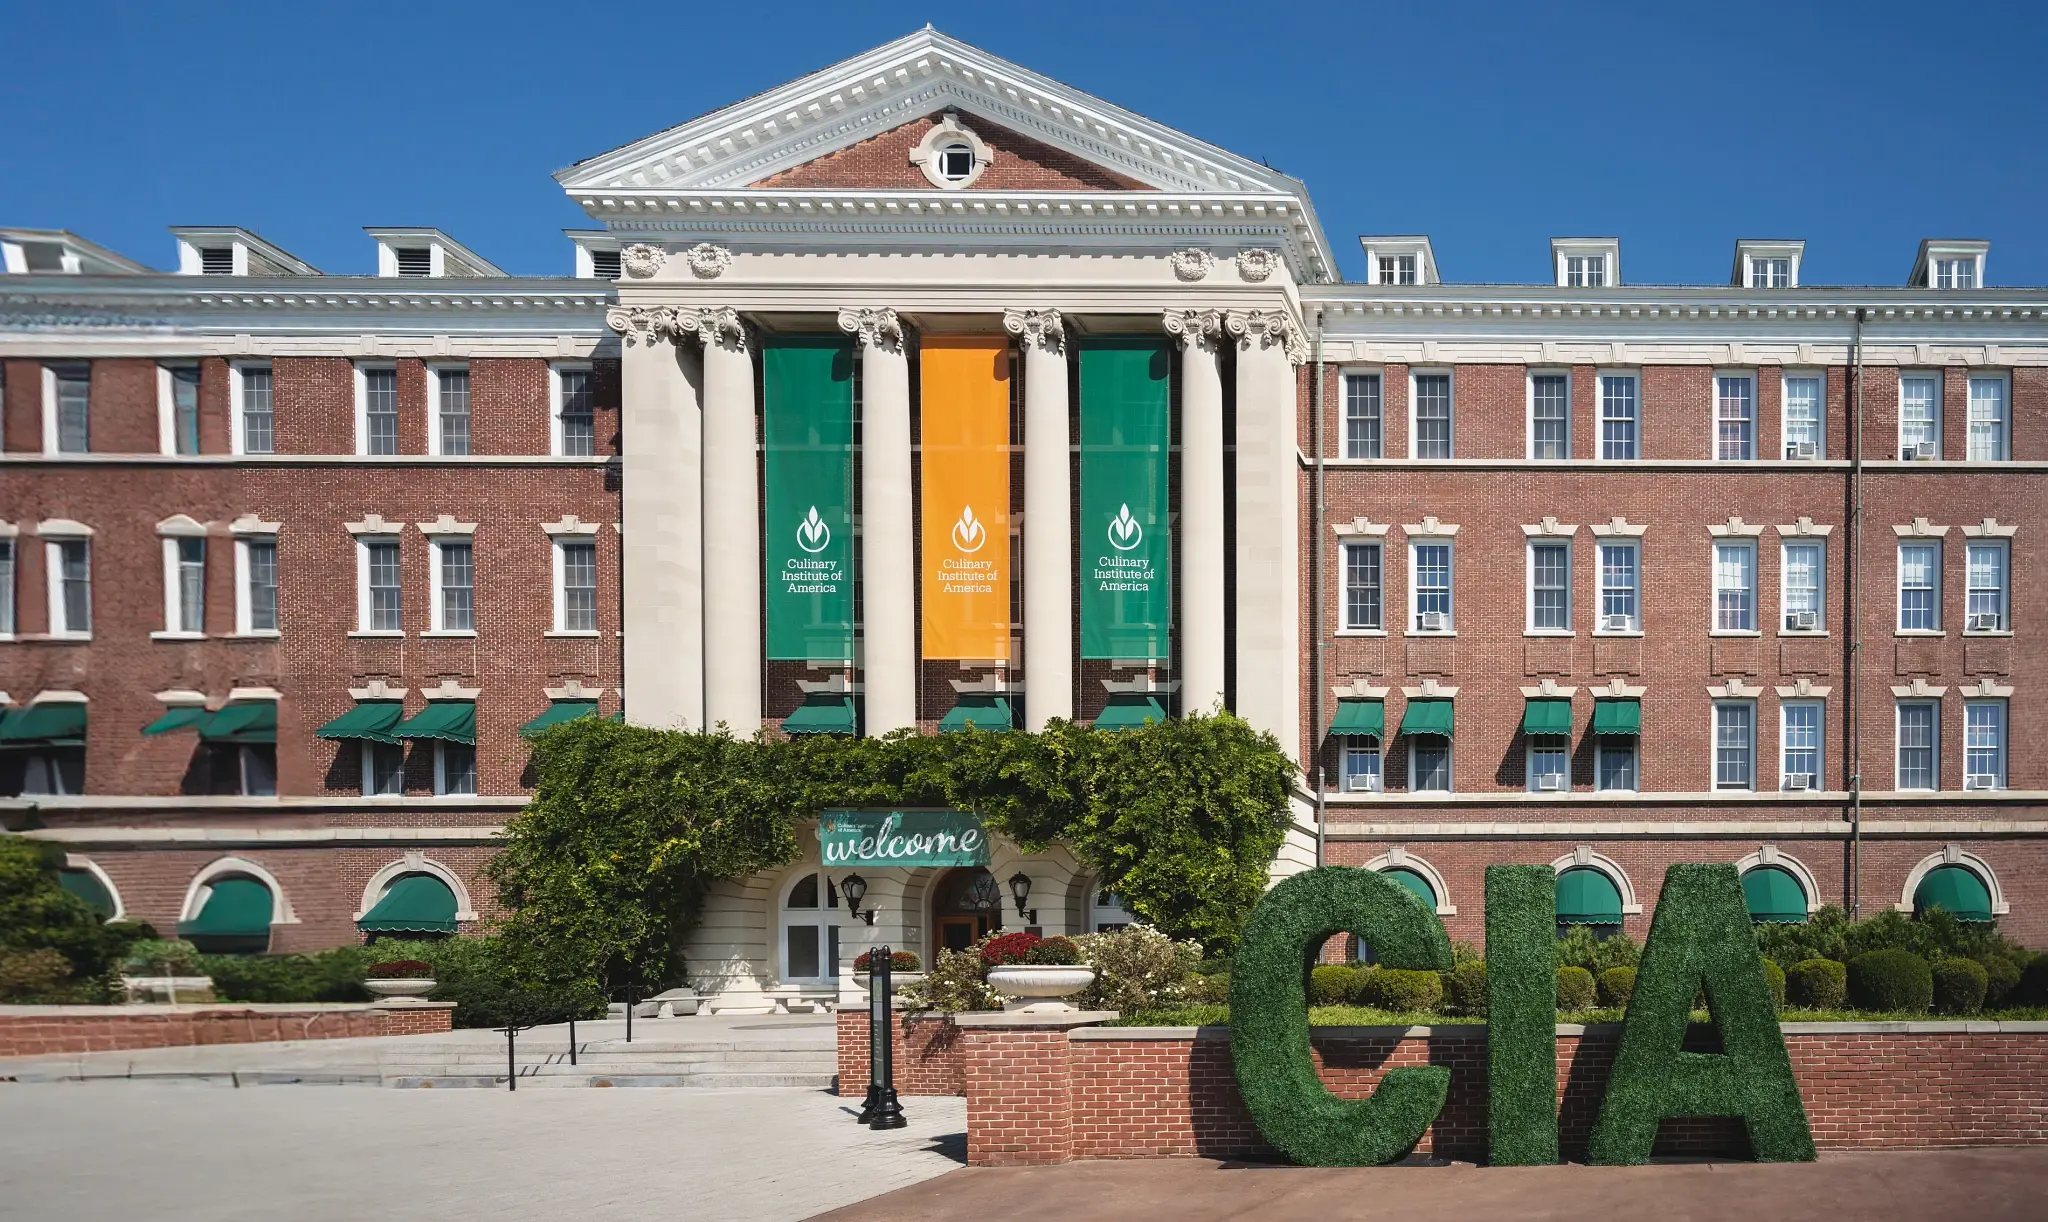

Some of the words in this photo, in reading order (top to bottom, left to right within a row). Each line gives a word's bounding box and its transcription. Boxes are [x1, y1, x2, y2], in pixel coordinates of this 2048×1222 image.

[787, 558, 837, 571] Culinary
[942, 558, 993, 571] Culinary
[1098, 555, 1150, 570] Culinary
[781, 570, 829, 581] Institute
[830, 570, 843, 581] of
[937, 570, 985, 581] Institute
[986, 569, 998, 581] of
[1093, 568, 1142, 579] Institute
[1143, 568, 1155, 579] of
[787, 582, 837, 593] America
[942, 582, 993, 593] America
[1099, 580, 1149, 591] America
[826, 816, 984, 862] welcome
[1229, 863, 1817, 1167] CIA
